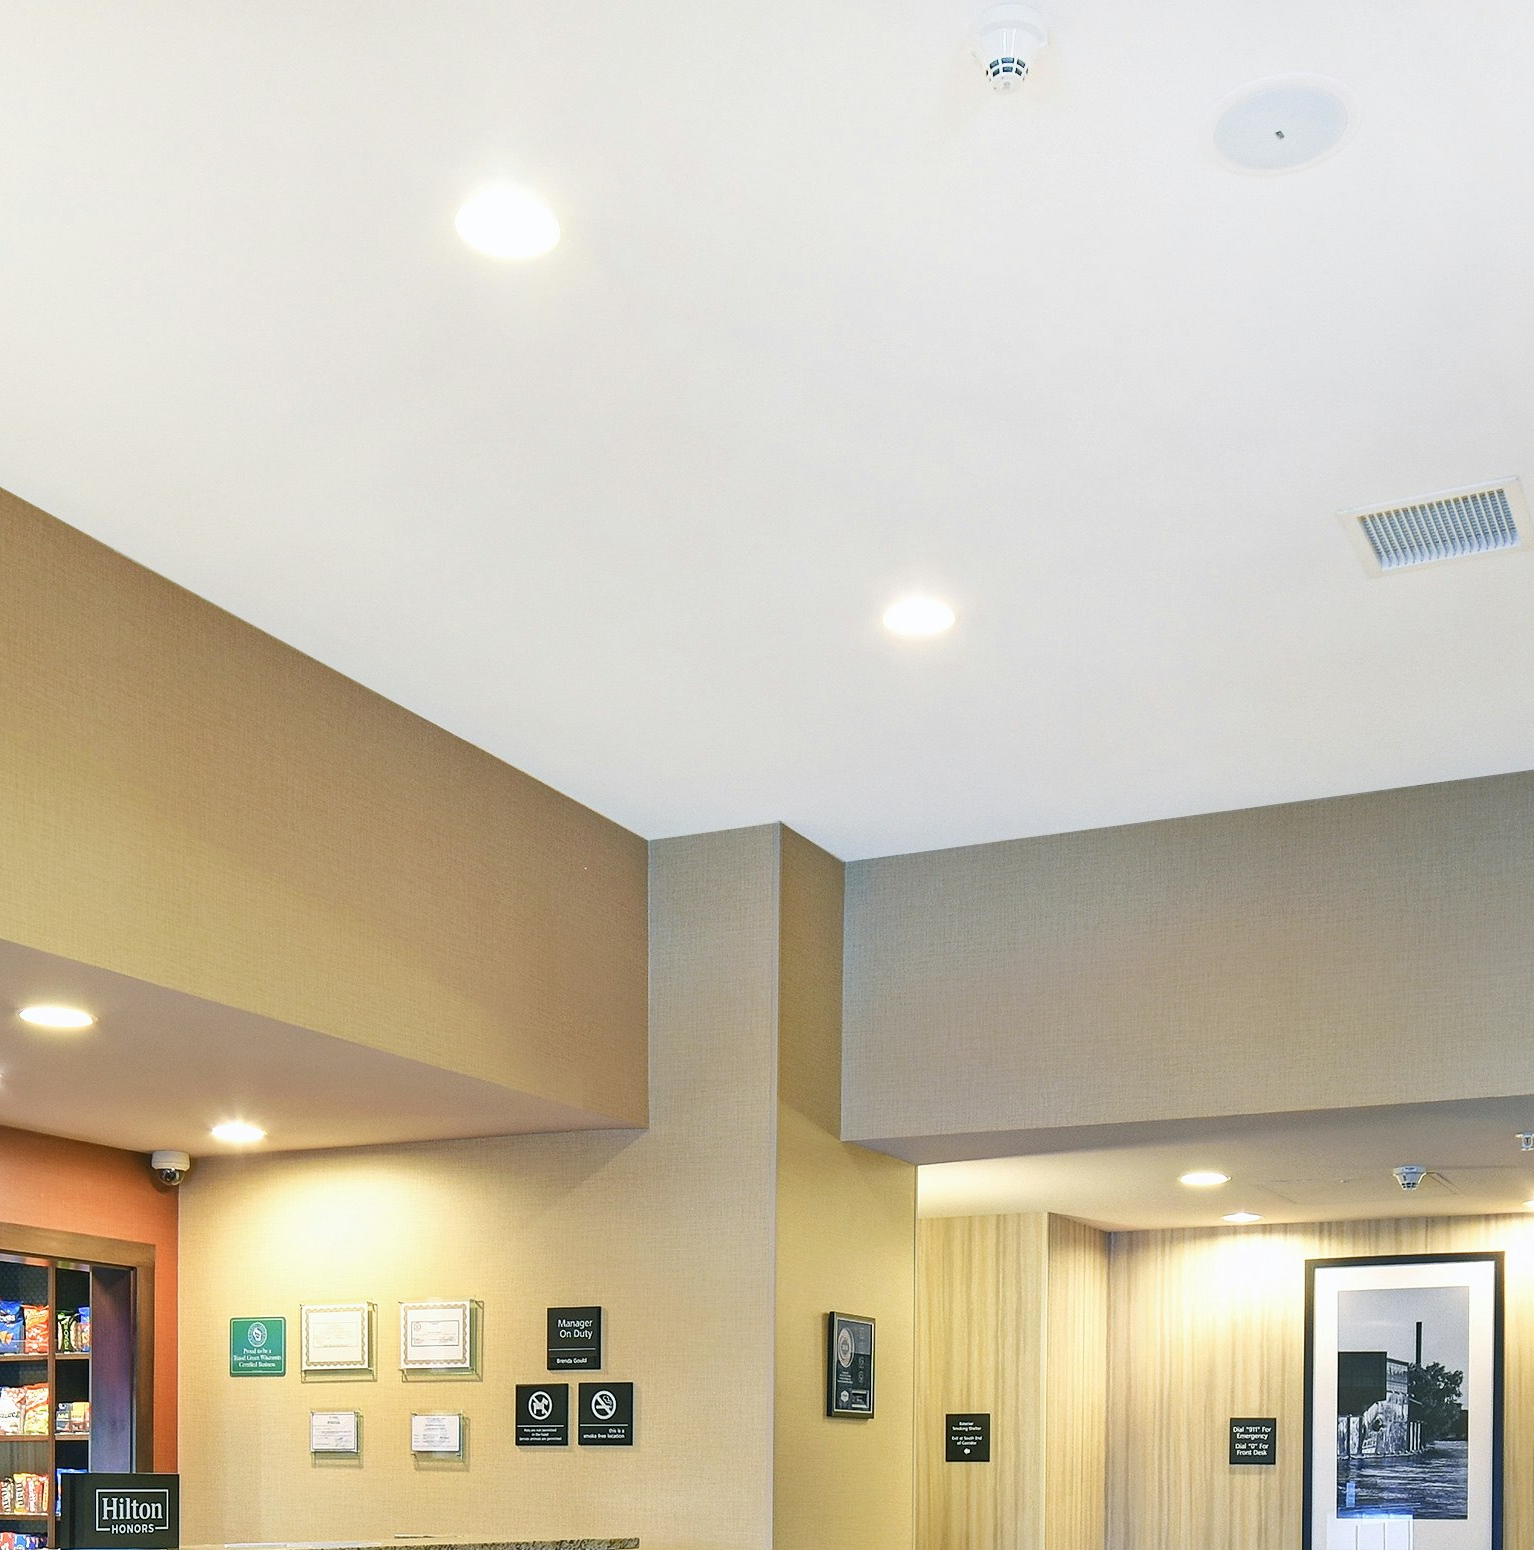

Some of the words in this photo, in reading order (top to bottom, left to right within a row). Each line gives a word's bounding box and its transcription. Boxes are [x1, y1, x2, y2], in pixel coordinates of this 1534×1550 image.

[557, 1319, 593, 1330] Manager
[559, 1329, 572, 1338] On
[573, 1329, 593, 1340] Duty
[101, 1497, 163, 1520] Hilton
[111, 1523, 155, 1534] HONORS
